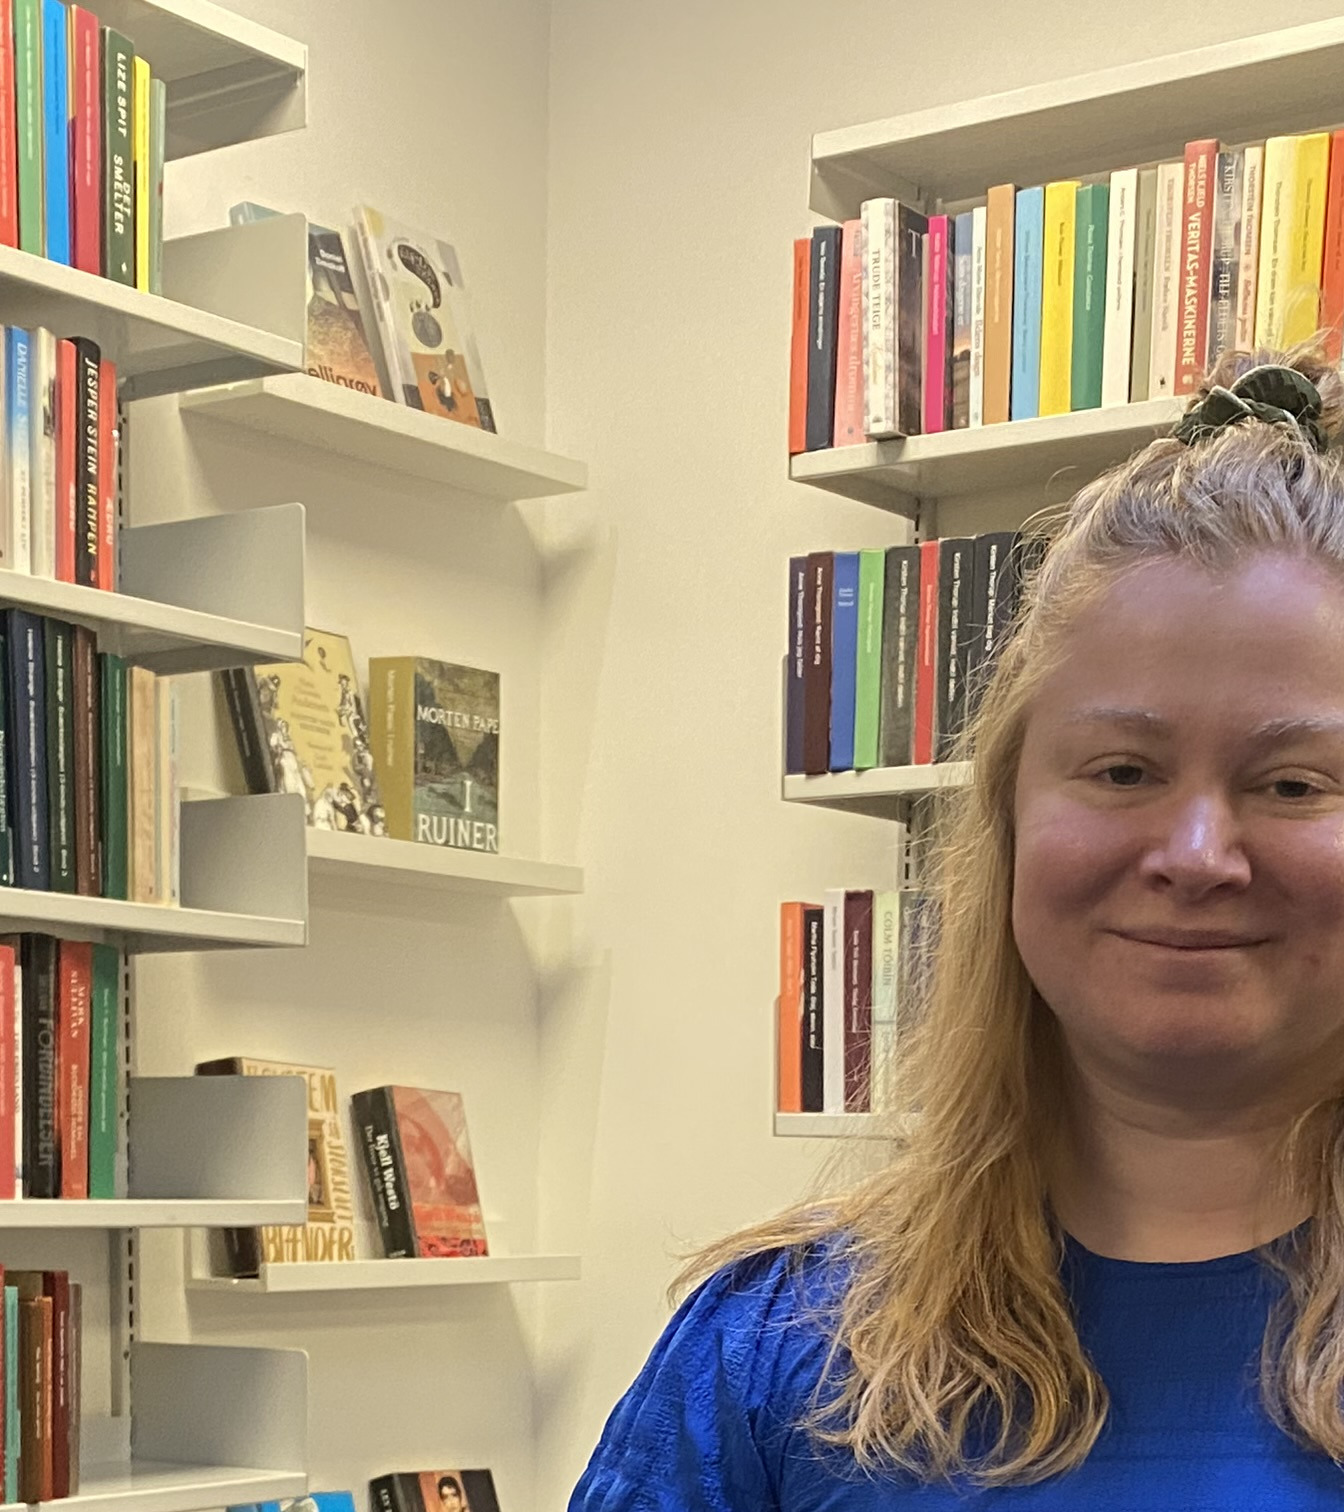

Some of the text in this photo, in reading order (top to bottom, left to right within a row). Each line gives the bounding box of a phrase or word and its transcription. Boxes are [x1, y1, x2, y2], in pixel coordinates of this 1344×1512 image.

[117, 52, 127, 138] LIZE SPIT
[113, 154, 124, 235] SMELTER
[871, 250, 882, 330] TRUDE TEIGE
[1181, 212, 1202, 366] VERITAS-MASKINERNE
[84, 358, 98, 555] JESPER STEIN RAMPEN
[417, 705, 499, 734] MORTEN PAPE
[417, 815, 496, 850] RUINER
